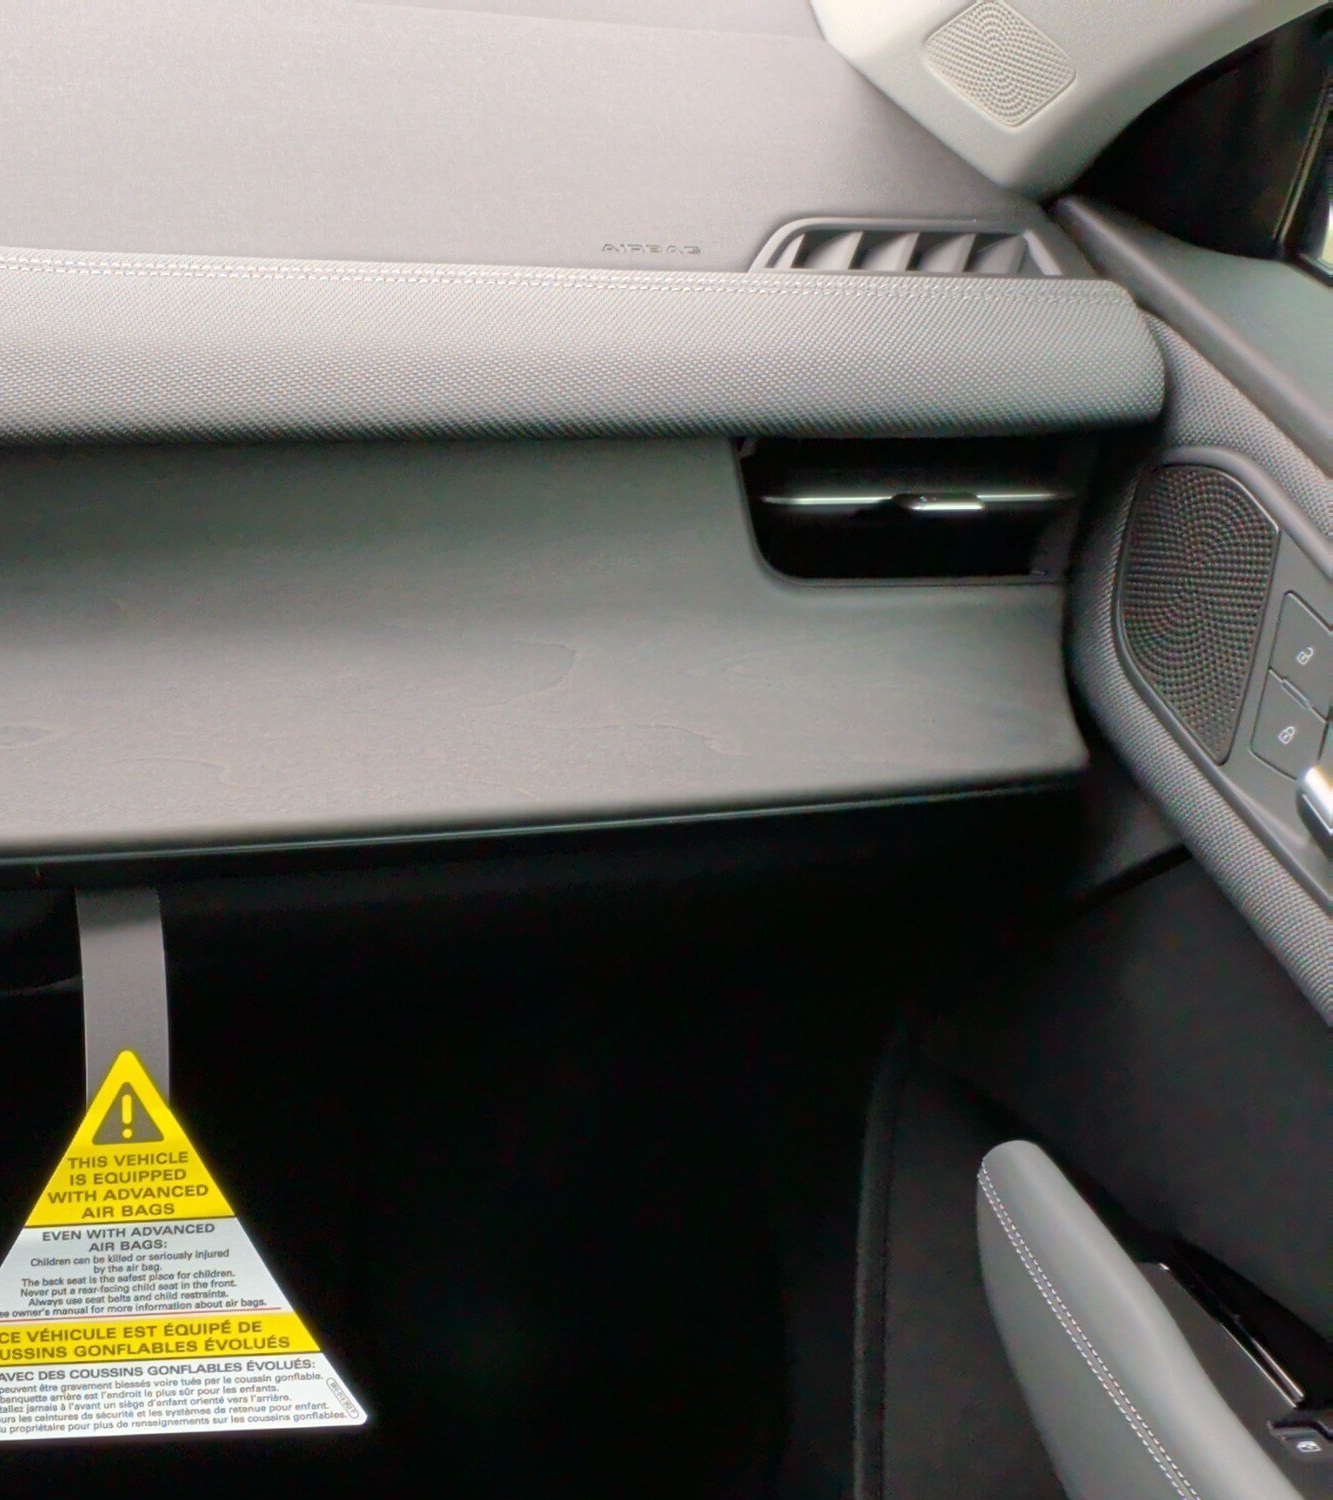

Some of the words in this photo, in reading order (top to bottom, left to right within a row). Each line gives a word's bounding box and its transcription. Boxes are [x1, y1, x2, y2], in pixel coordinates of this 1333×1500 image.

[67, 1155, 107, 1169] THIS
[113, 1151, 188, 1166] VEHICLE
[70, 1173, 86, 1186] IS
[93, 1168, 186, 1184] EQUIPPED
[47, 1190, 97, 1203] WITH
[103, 1184, 208, 1200] ADVANCED
[81, 1205, 114, 1219] AIR
[121, 1202, 174, 1217] BAGS
[42, 1230, 81, 1242] EVEN
[86, 1228, 125, 1239] WITH
[131, 1223, 215, 1236] ADVANCED
[89, 1241, 114, 1252] AIR
[120, 1238, 167, 1250] BAGS:
[26, 1327, 116, 1342] VÉHICULE
[123, 1325, 157, 1338] EST
[164, 1319, 231, 1336] ÉQUIPÉ
[238, 1320, 261, 1333] DE
[74, 1340, 197, 1357] GONFLABLES
[204, 1336, 289, 1351] ÉVOLUÉS
[38, 1369, 65, 1380] DES
[69, 1366, 143, 1379] COUSSINS
[147, 1362, 242, 1375] GONFLABLES
[246, 1357, 315, 1371] ÉVOLUÉS:
